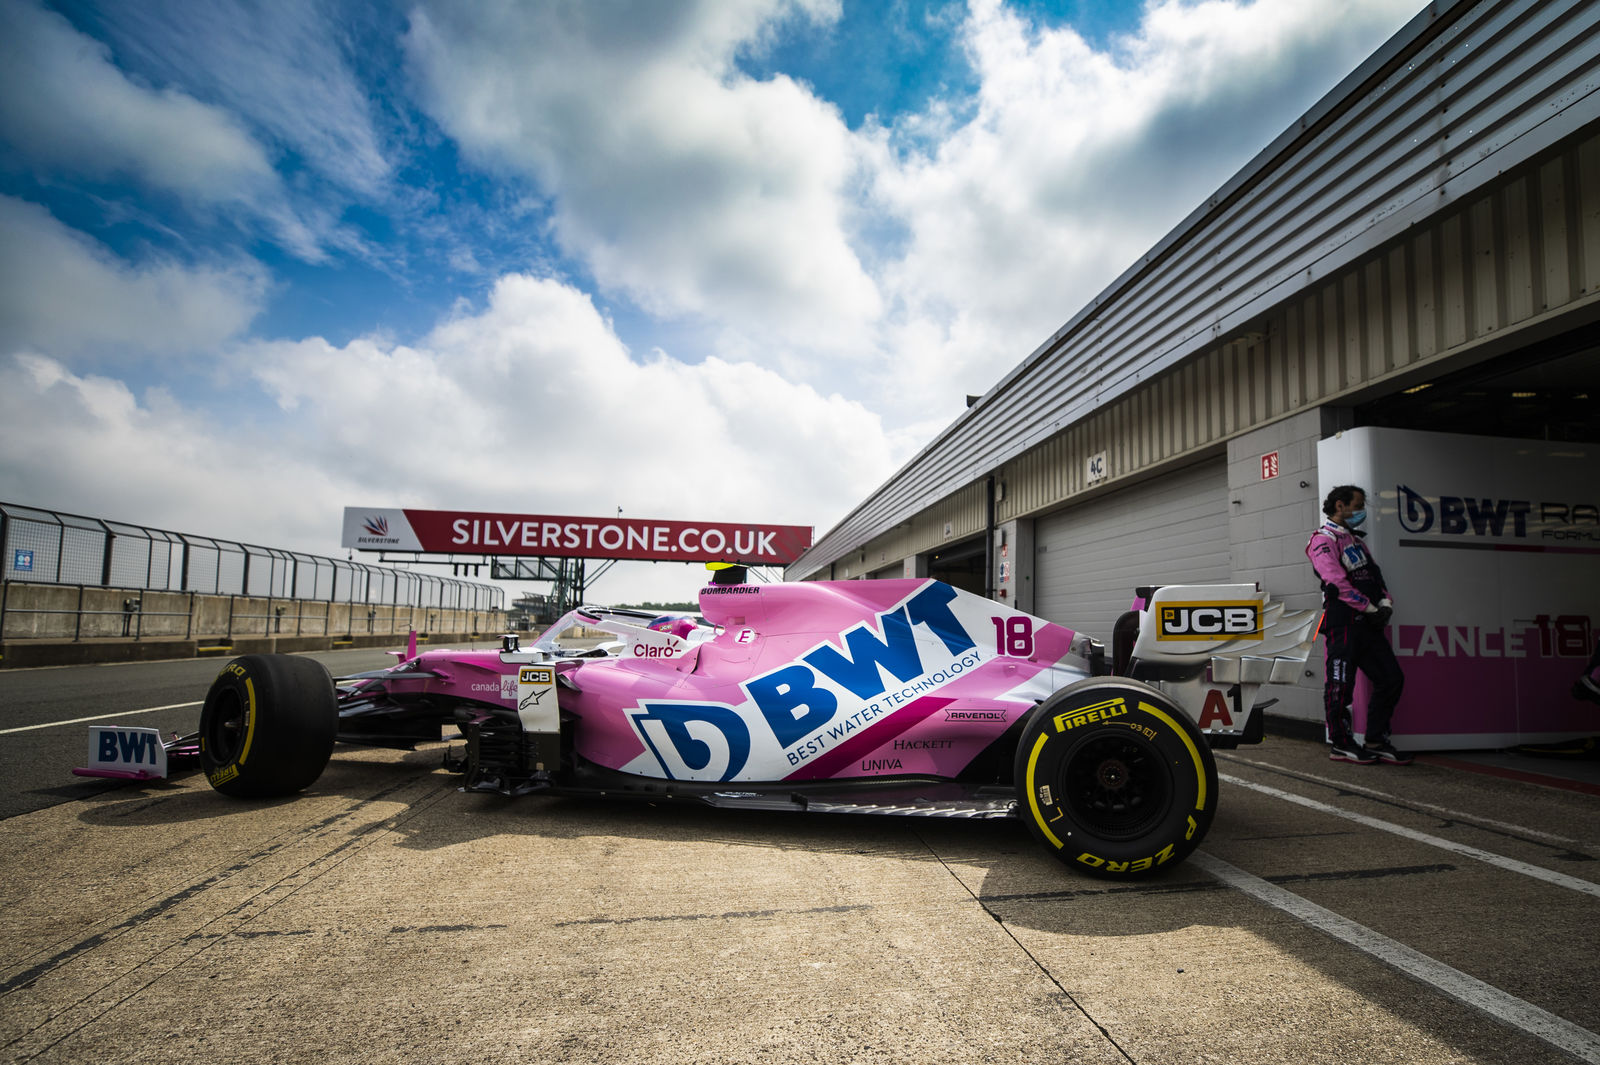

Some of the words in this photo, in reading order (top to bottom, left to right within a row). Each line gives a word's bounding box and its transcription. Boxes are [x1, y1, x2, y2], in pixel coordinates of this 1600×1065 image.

[1090, 457, 1103, 475] 4C
[1440, 496, 1531, 537] BWT
[357, 536, 400, 545] SILVERSTONE
[451, 518, 777, 556] SILVERSTONE.CO.UK
[700, 586, 760, 595] BOMBARDIER
[1164, 608, 1255, 633] JCB
[738, 630, 751, 643] E
[990, 616, 1033, 656] 18
[1391, 622, 1528, 658] LANCE
[1533, 615, 1592, 657] 18
[634, 642, 675, 658] Claro
[521, 671, 550, 682] JCB
[745, 579, 977, 749] BWT
[471, 682, 500, 692] canada
[786, 734, 825, 766] BEST
[827, 703, 884, 740] WATER
[882, 651, 981, 708] TECHNOLOGY
[1053, 697, 1128, 733] PIRELLI
[98, 731, 157, 765] BWT
[894, 740, 955, 750] HACKETT
[862, 758, 903, 772] UNIVA
[1185, 815, 1198, 840] P
[1076, 843, 1175, 872] ZERO
